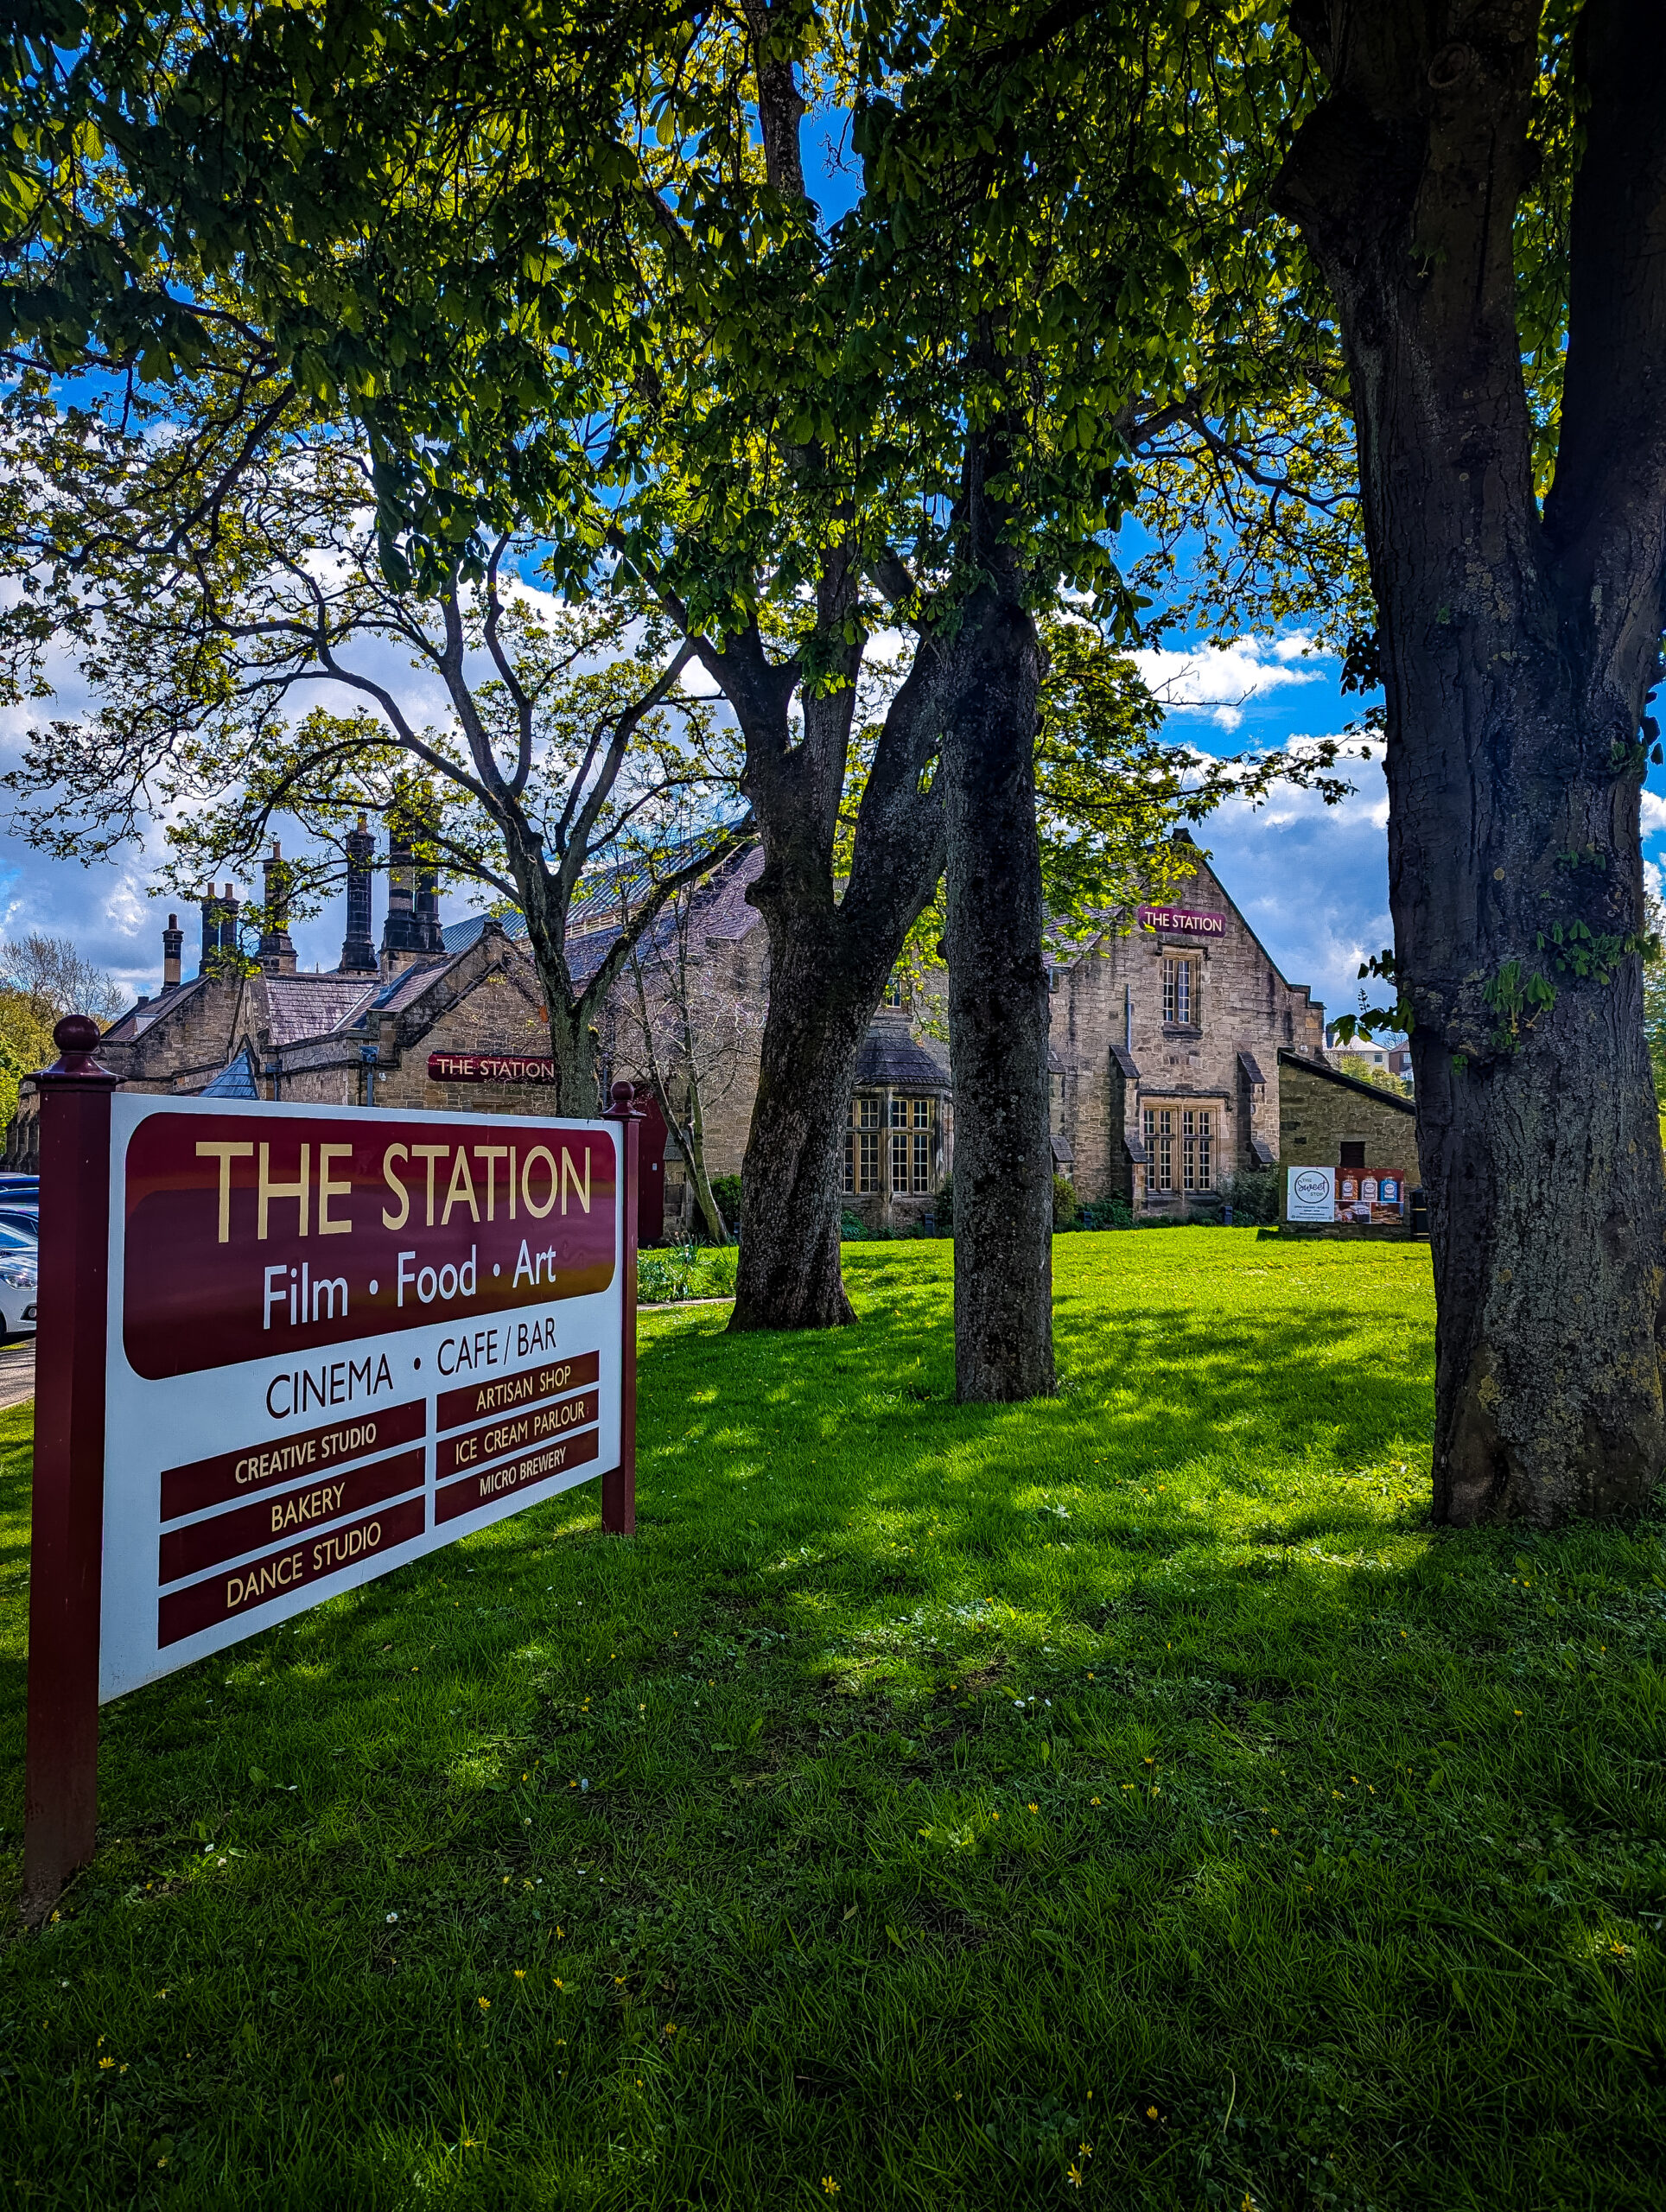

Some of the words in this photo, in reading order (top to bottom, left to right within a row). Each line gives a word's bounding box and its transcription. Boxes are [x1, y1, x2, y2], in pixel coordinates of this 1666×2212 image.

[1145, 912, 1170, 927] THE
[1172, 914, 1223, 932] STATION
[436, 1058, 474, 1075] THE
[480, 1060, 555, 1077] STATION
[195, 1141, 353, 1243] THE
[382, 1142, 591, 1230] STATION
[1297, 1179, 1327, 1193] Sweet
[263, 1262, 348, 1330] Film
[397, 1243, 477, 1307] Food
[512, 1238, 556, 1288] Art
[265, 1352, 394, 1420] CINEMA
[476, 1376, 534, 1412] ARTISAN
[539, 1365, 571, 1393] SHOP
[235, 1440, 316, 1484] CREATIVE
[321, 1422, 377, 1459] STUDIO
[455, 1436, 478, 1465] ICE
[484, 1420, 528, 1453] CREAM
[534, 1401, 586, 1436] PARLOUR
[480, 1465, 518, 1497] MICRO
[519, 1446, 567, 1481] BREWERY
[271, 1481, 346, 1533] BAKERY
[226, 1551, 303, 1609] DANCE
[313, 1522, 382, 1571] STUDIO
